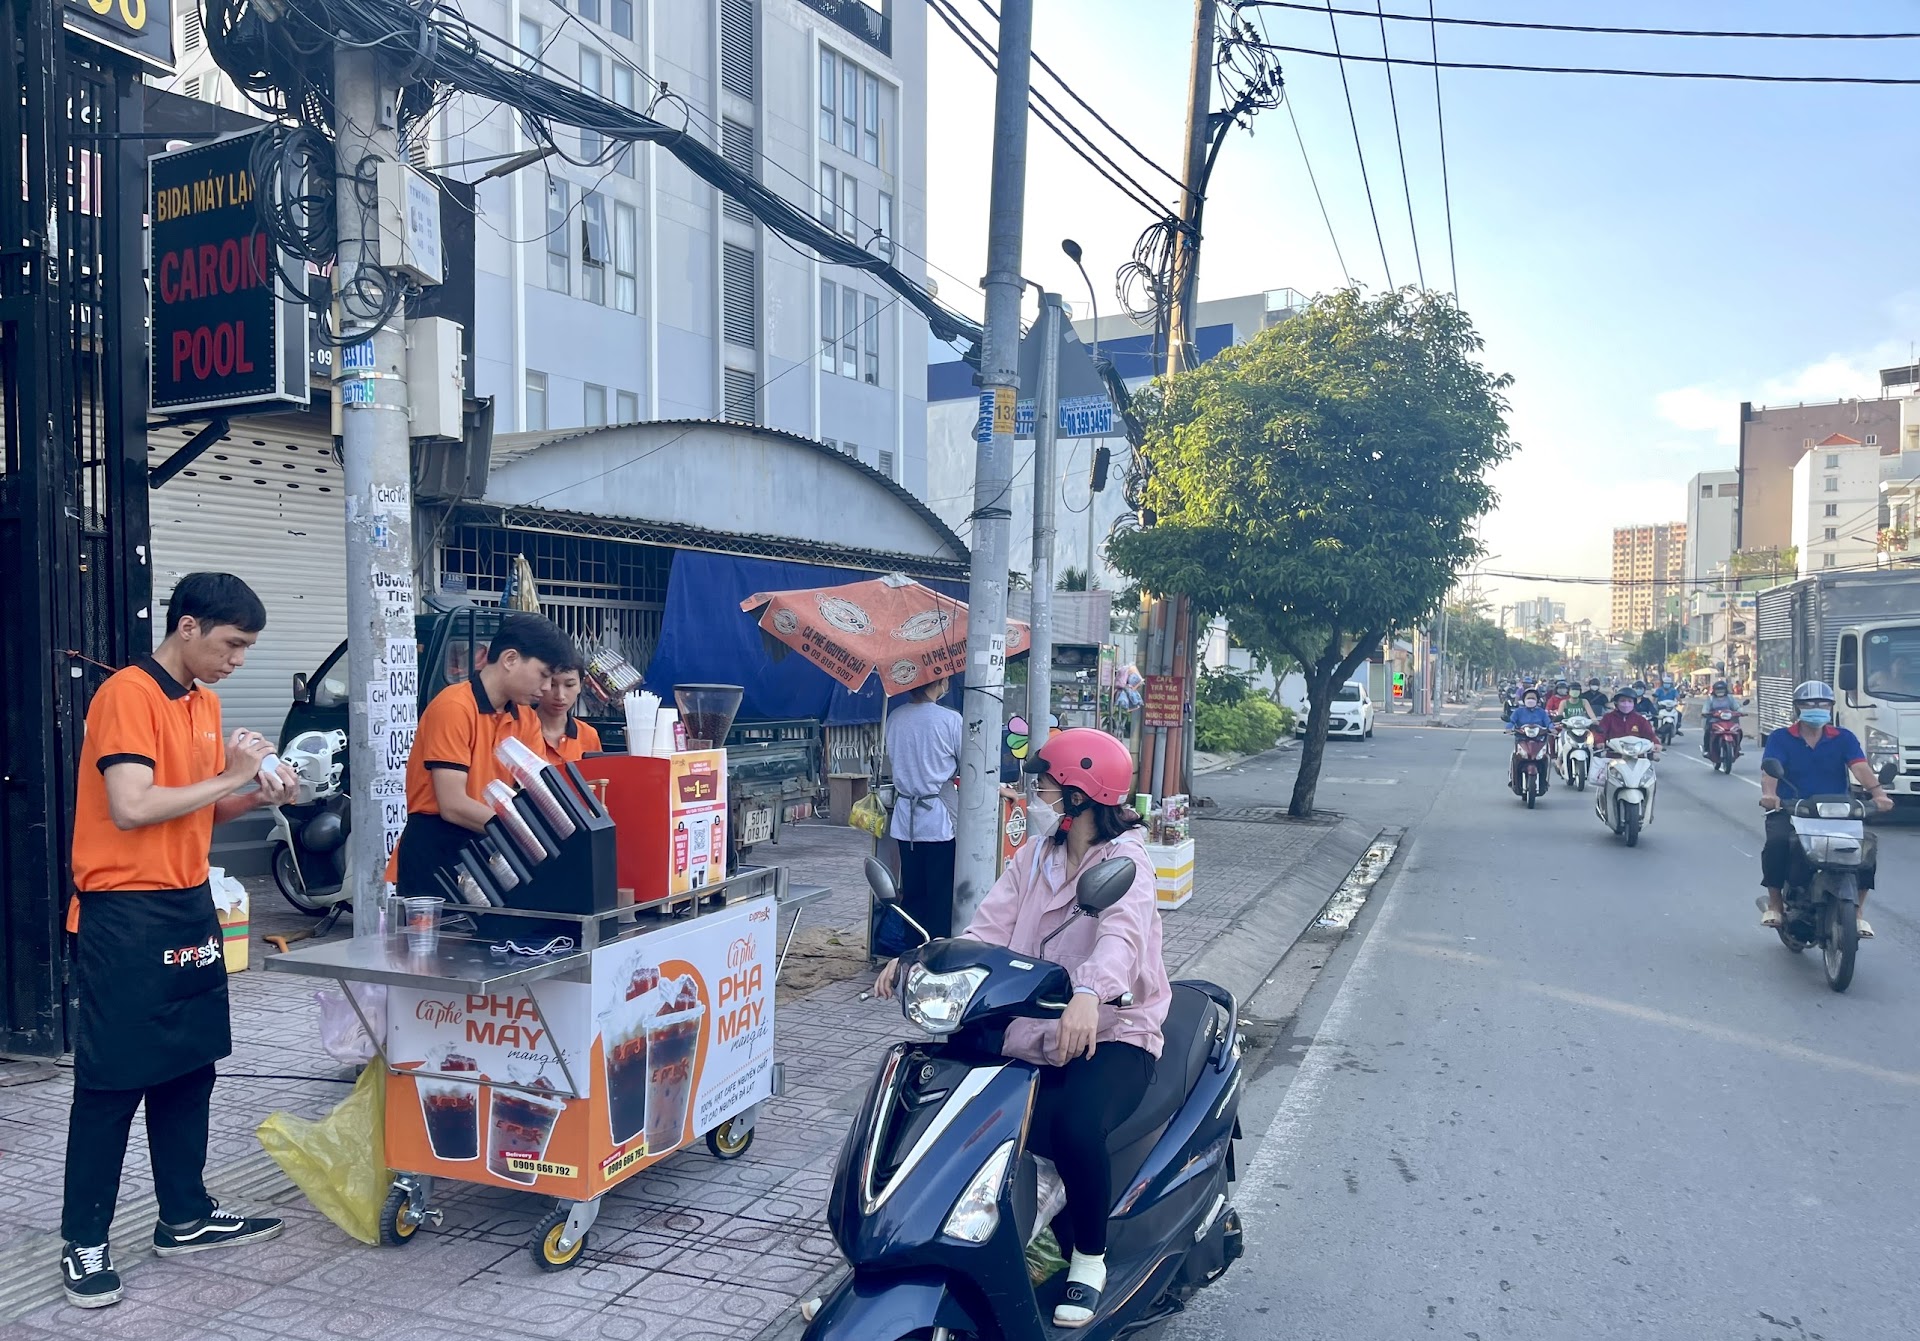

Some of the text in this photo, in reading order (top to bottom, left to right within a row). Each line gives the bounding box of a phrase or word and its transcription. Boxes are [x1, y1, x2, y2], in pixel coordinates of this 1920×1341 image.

[157, 169, 256, 222] BIDA MÁY LẠN
[160, 232, 266, 304] CAROM
[172, 320, 254, 382] POOL
[1067, 409, 1112, 436] 08.359.34567
[391, 645, 406, 664] CHO
[372, 689, 387, 702] CH
[390, 703, 407, 723] CHO
[718, 963, 762, 1009] PHA
[415, 999, 463, 1030] Cà phê
[465, 993, 540, 1023] PHA
[718, 997, 765, 1046] MÁY
[465, 1019, 545, 1051] MÁY
[507, 1050, 549, 1075] mang
[505, 1151, 533, 1159] Delivery
[513, 1159, 571, 1176] 0909 666 792
